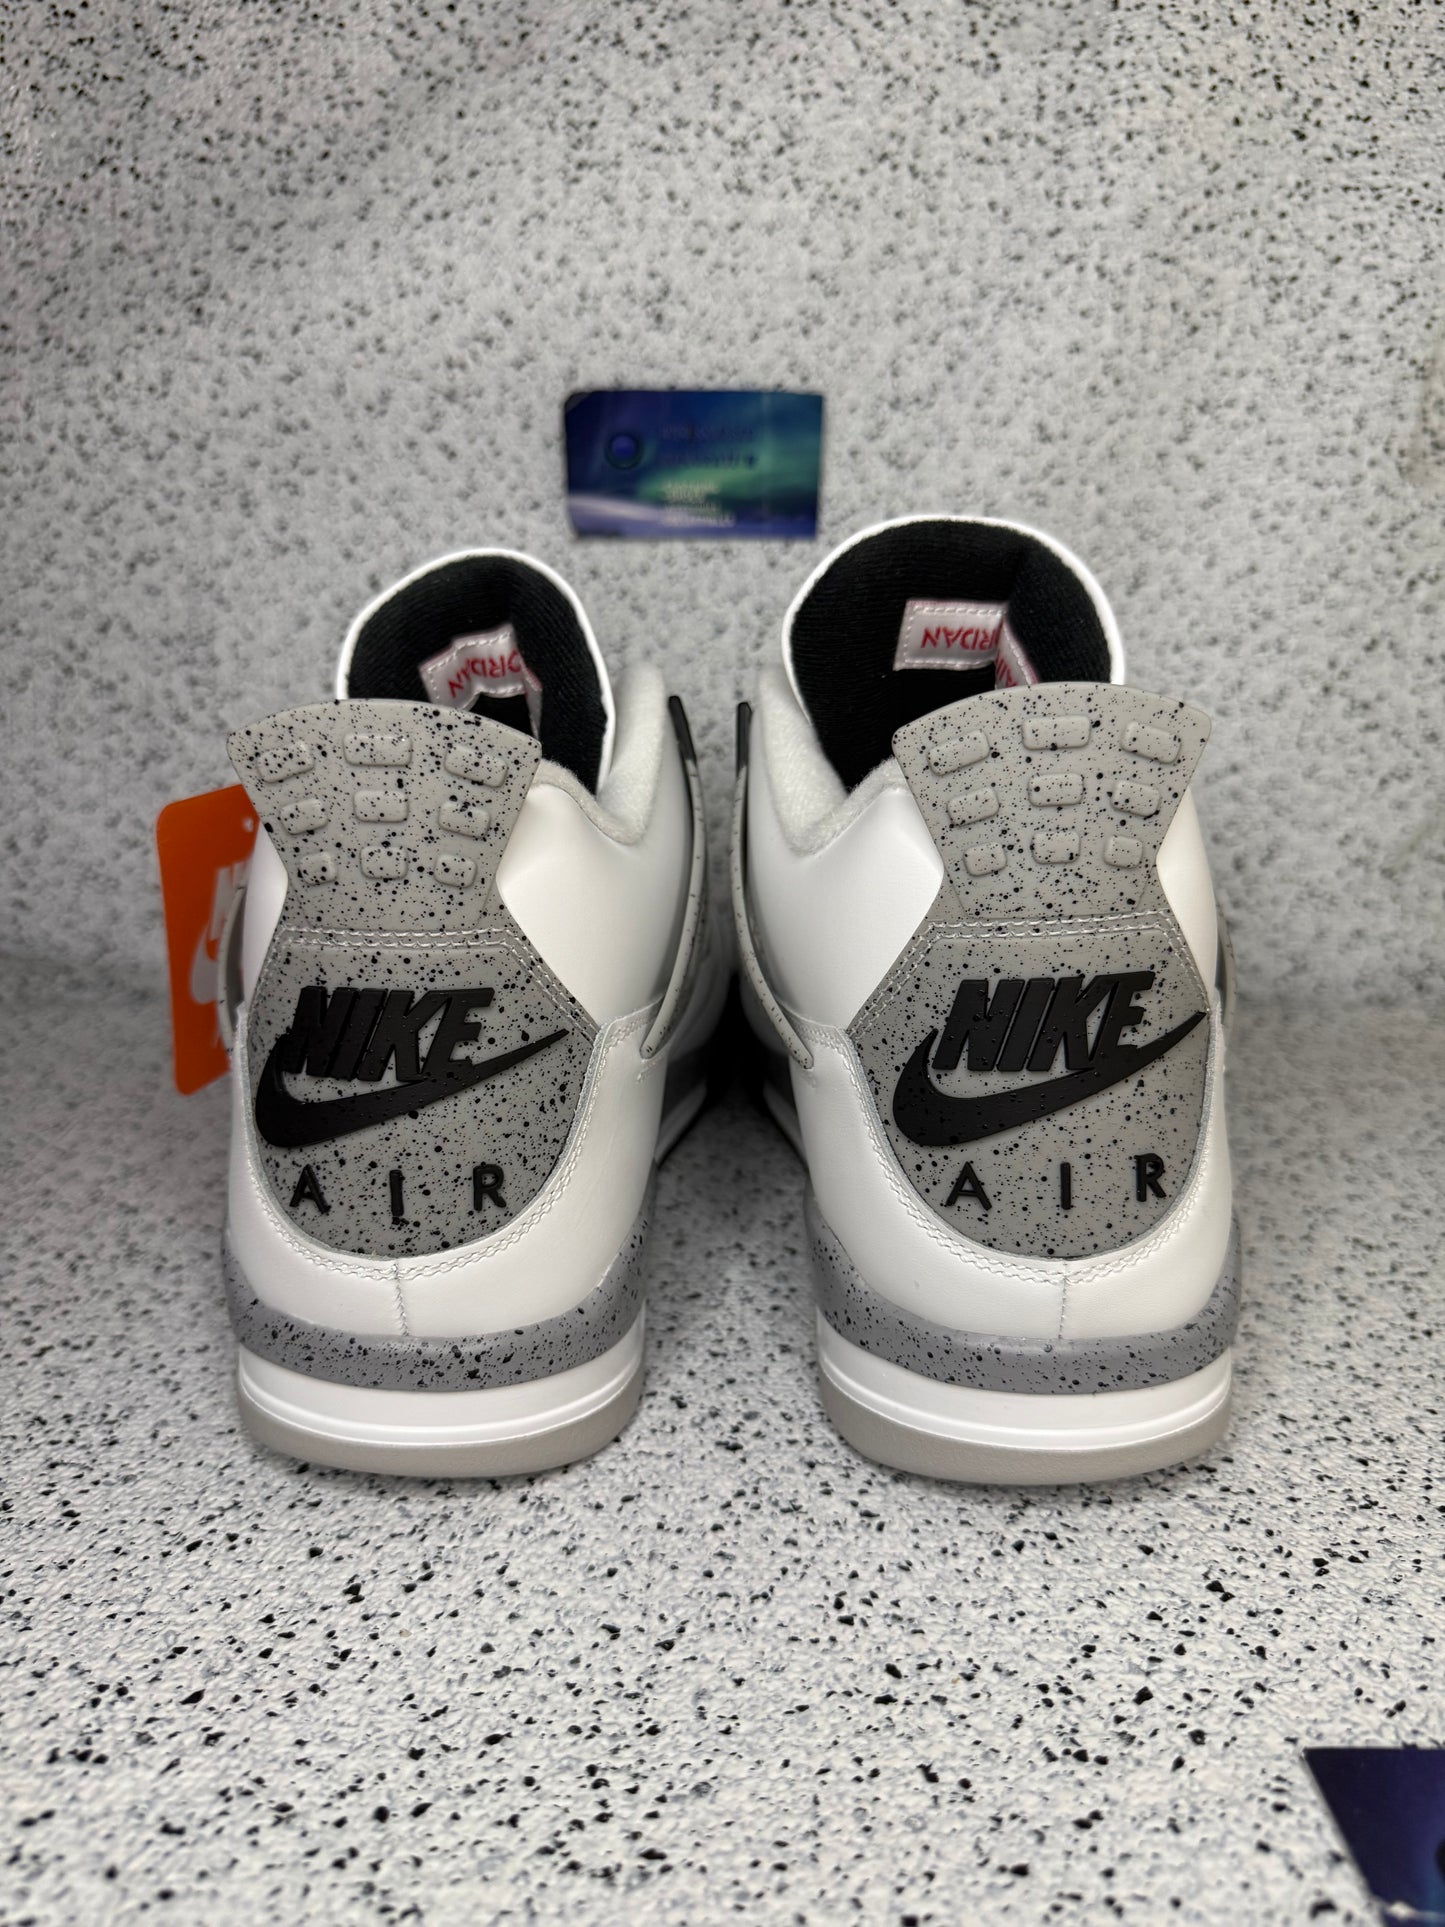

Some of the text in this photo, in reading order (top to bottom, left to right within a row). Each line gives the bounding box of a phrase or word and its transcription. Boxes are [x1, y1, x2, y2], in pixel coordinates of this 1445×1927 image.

[920, 625, 999, 651] RDAN
[282, 985, 495, 1082] NIKE
[932, 970, 1156, 1072] NIKE
[289, 1163, 507, 1218] AIR
[945, 1152, 1167, 1211] AIR
